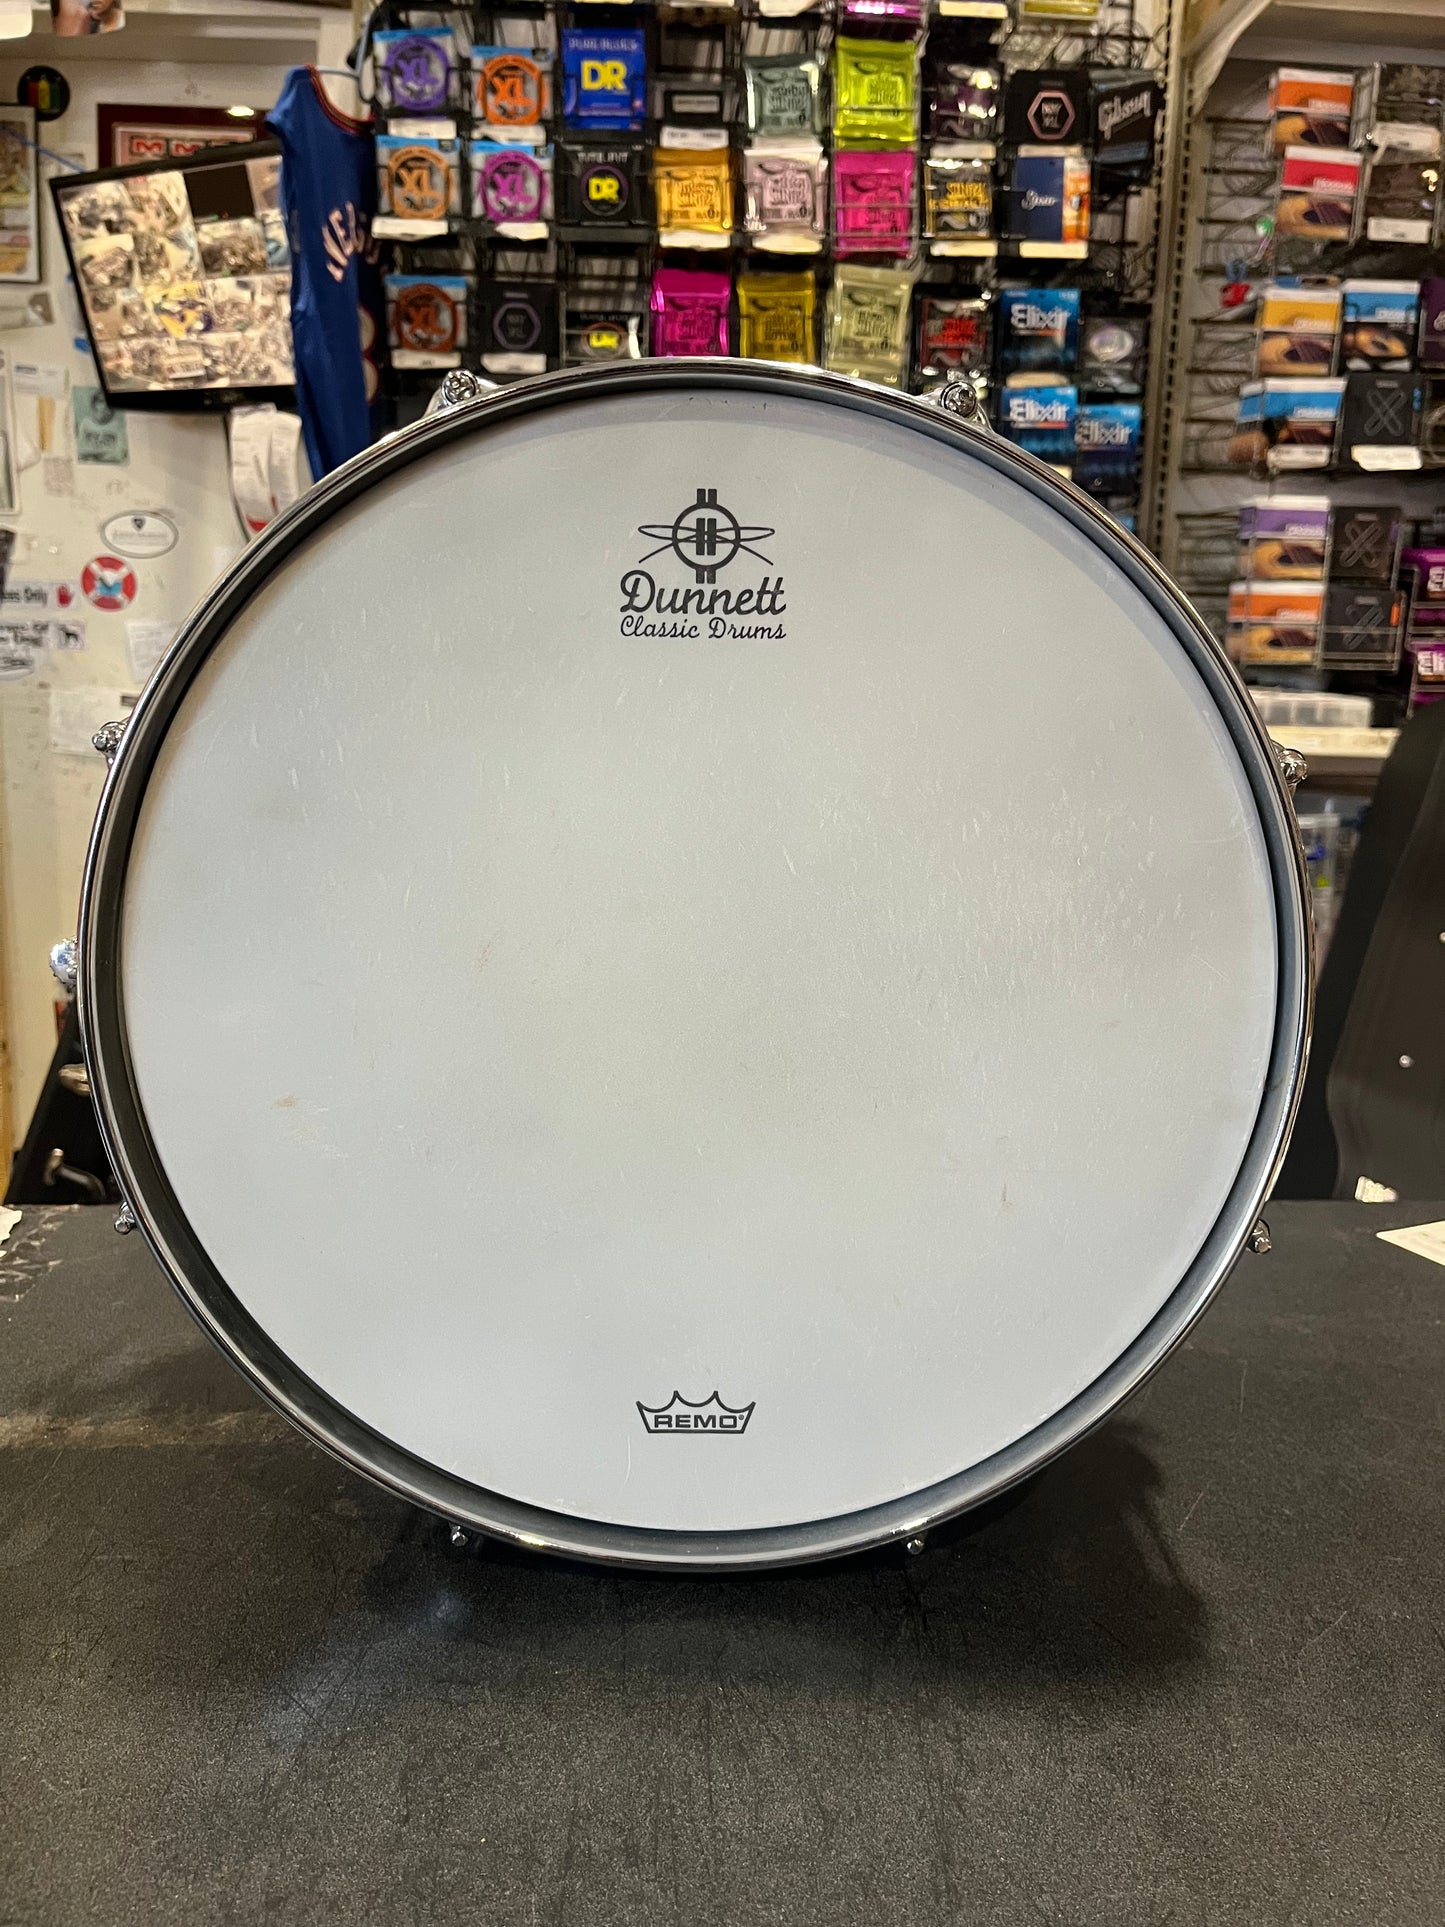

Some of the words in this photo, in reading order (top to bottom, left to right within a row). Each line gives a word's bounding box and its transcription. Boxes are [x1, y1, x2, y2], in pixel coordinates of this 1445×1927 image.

[581, 60, 627, 91] DR
[491, 75, 534, 106] XL
[398, 168, 442, 198] XL
[491, 173, 534, 204] XL
[589, 176, 619, 202] DR
[1010, 303, 1071, 330] Elixir
[1009, 398, 1070, 422] Elixir
[1074, 418, 1133, 445] Elixir
[620, 569, 787, 616] Dunnett
[620, 615, 700, 639] Classic
[708, 616, 787, 639] Drums
[654, 1414, 738, 1429] REMO
